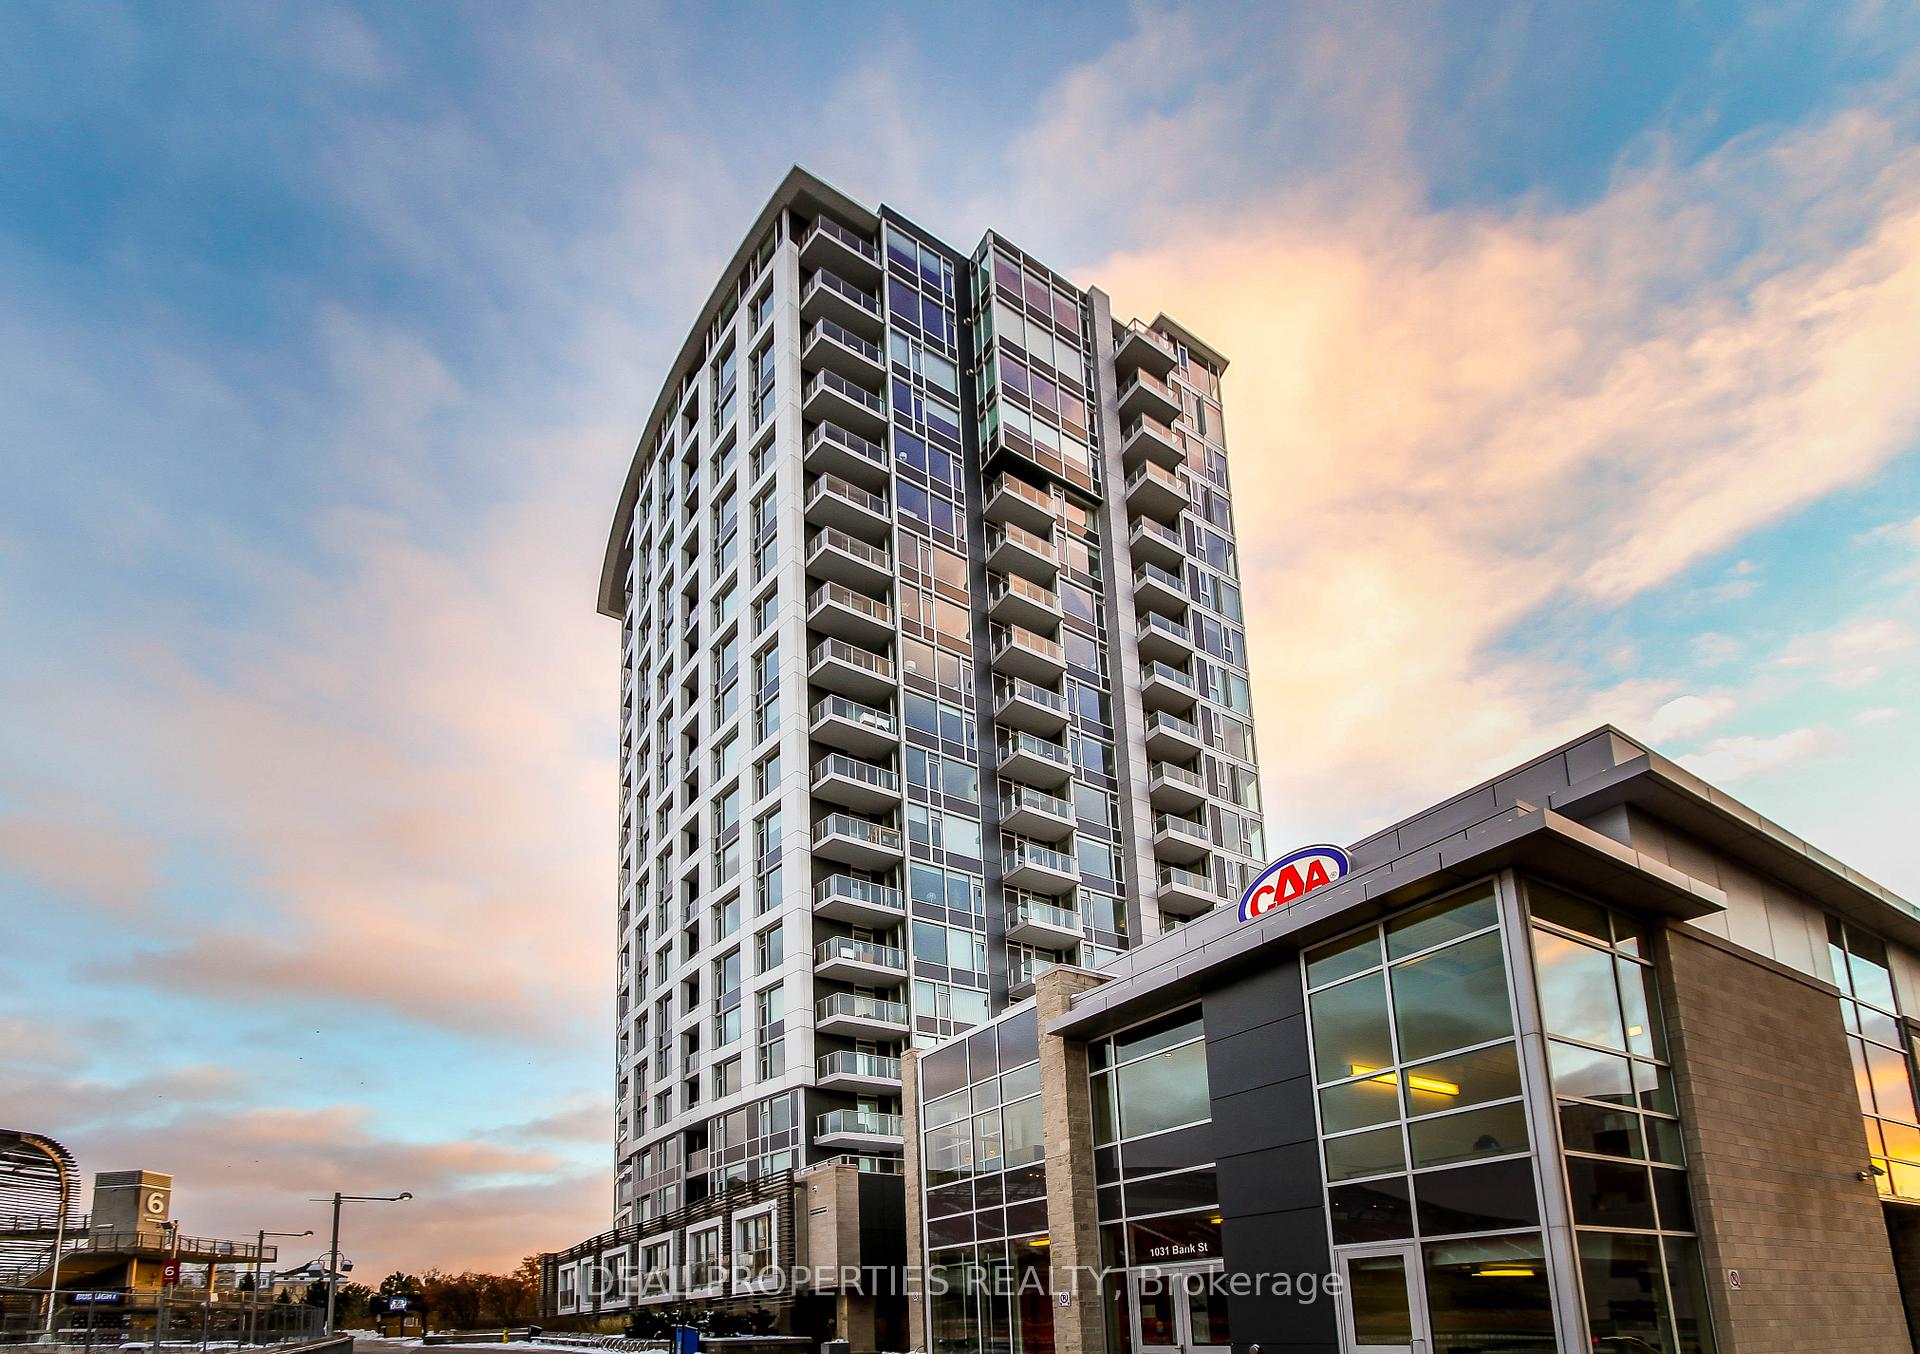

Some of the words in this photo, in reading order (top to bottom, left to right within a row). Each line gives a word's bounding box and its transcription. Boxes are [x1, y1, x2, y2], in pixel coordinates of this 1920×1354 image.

[1250, 859, 1331, 917] CAA
[147, 1191, 165, 1213] 6
[1150, 1246, 1170, 1257] 1031
[1172, 1243, 1196, 1255] Bank
[1197, 1242, 1208, 1252] St
[164, 1266, 175, 1276] 6
